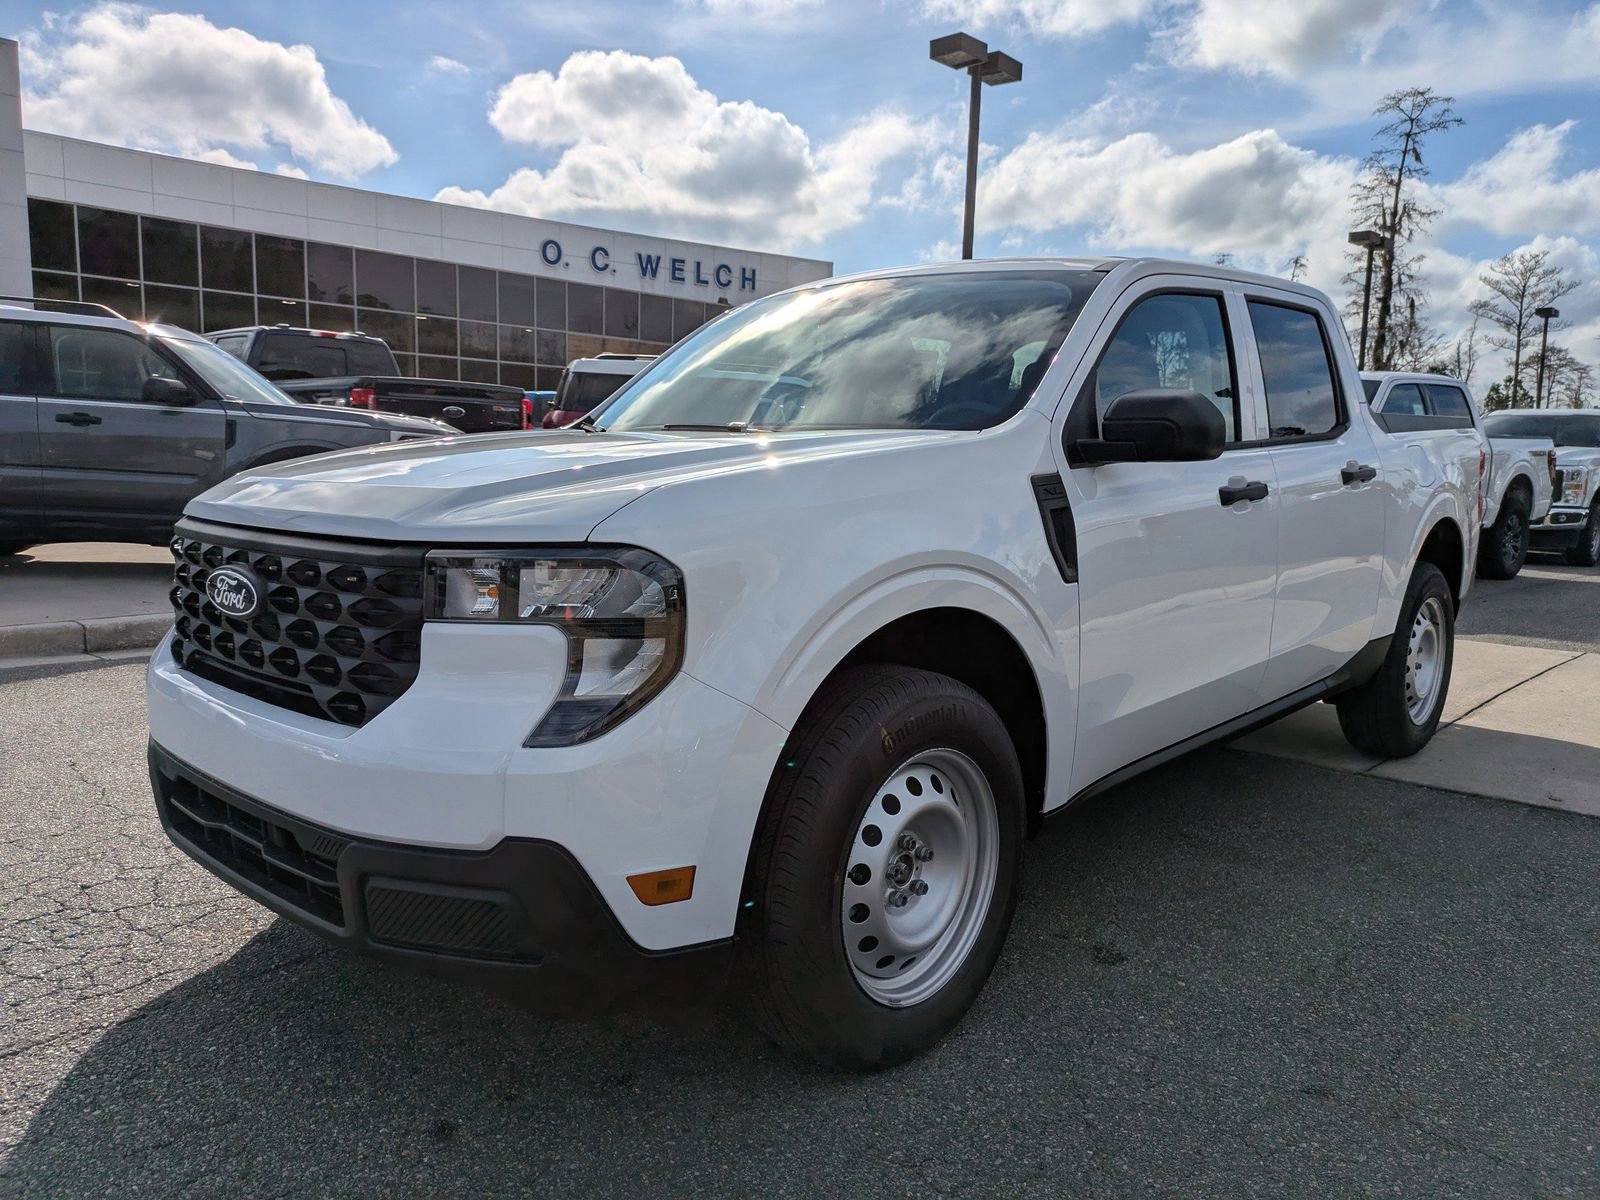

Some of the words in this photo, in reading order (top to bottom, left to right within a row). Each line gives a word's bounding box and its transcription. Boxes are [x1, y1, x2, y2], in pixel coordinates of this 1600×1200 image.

[541, 239, 570, 268] O.
[590, 246, 617, 274] C.
[636, 252, 757, 291] WELCH
[214, 575, 246, 610] Ford
